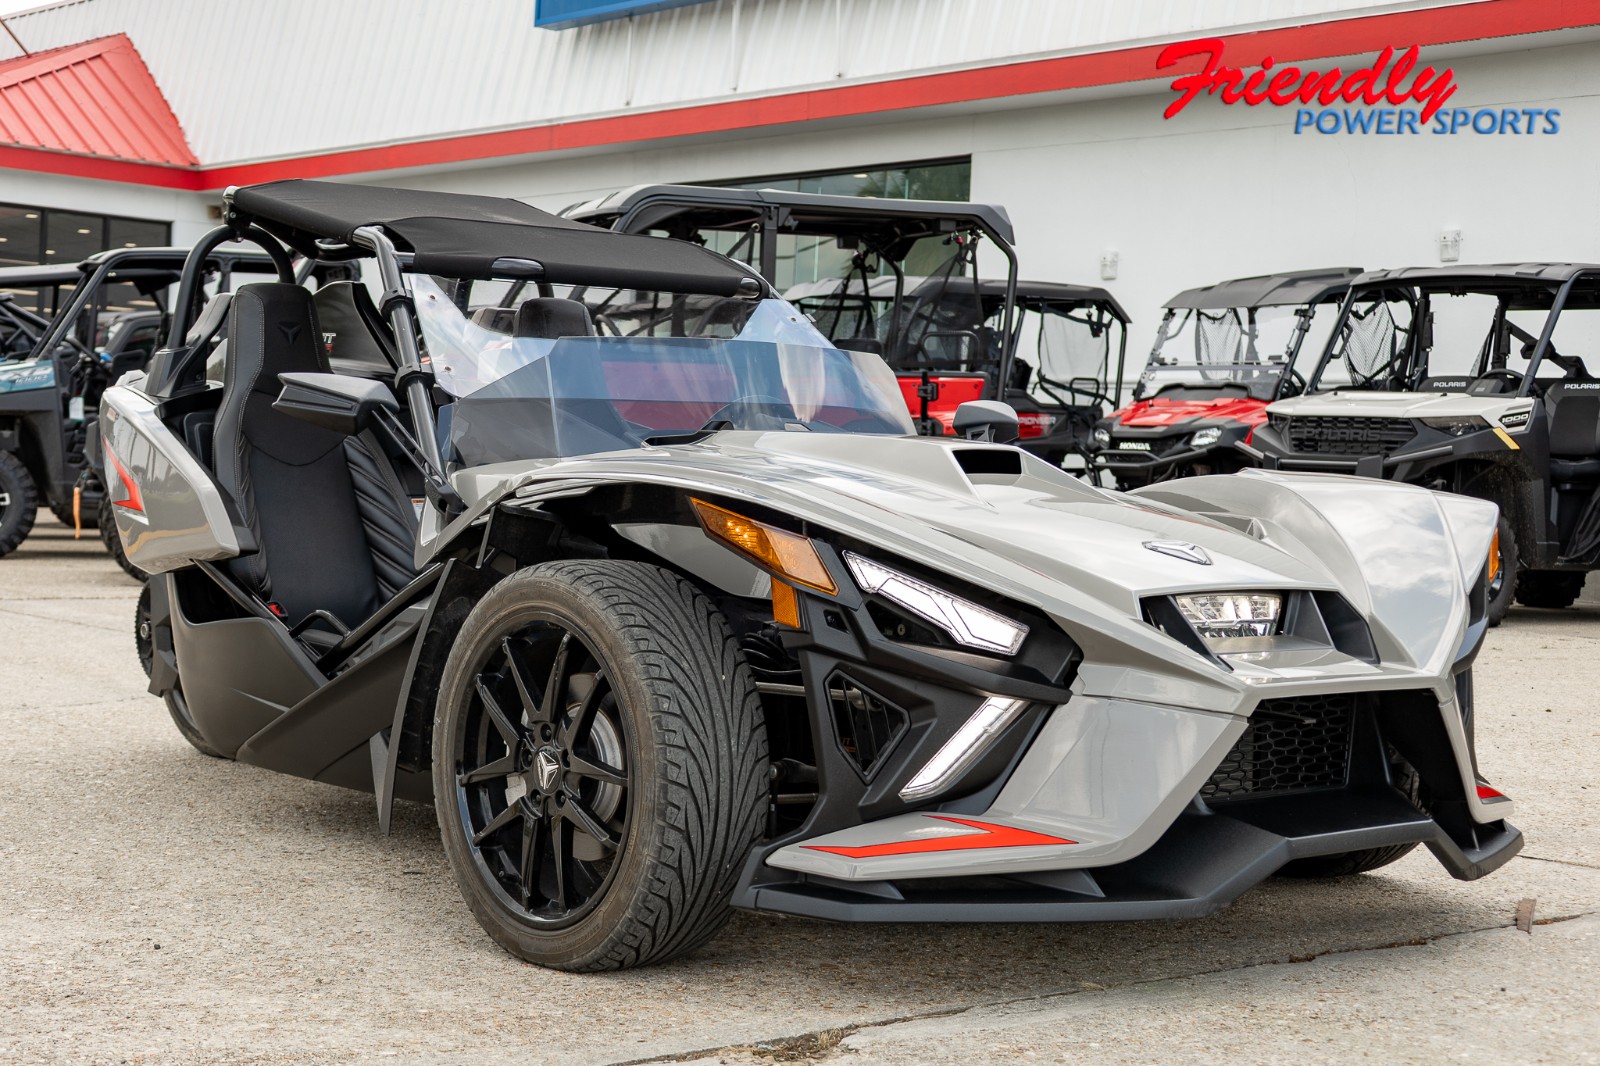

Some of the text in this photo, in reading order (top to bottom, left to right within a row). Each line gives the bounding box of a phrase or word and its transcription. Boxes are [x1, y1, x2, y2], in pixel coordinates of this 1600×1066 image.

[1156, 38, 1458, 125] Friendly
[1294, 108, 1561, 135] POWER SPORTS
[1018, 416, 1056, 425] PIONEER
[1501, 413, 1529, 424] 1000
[1304, 427, 1381, 442] POLARIS
[1119, 442, 1151, 451] HONDA
